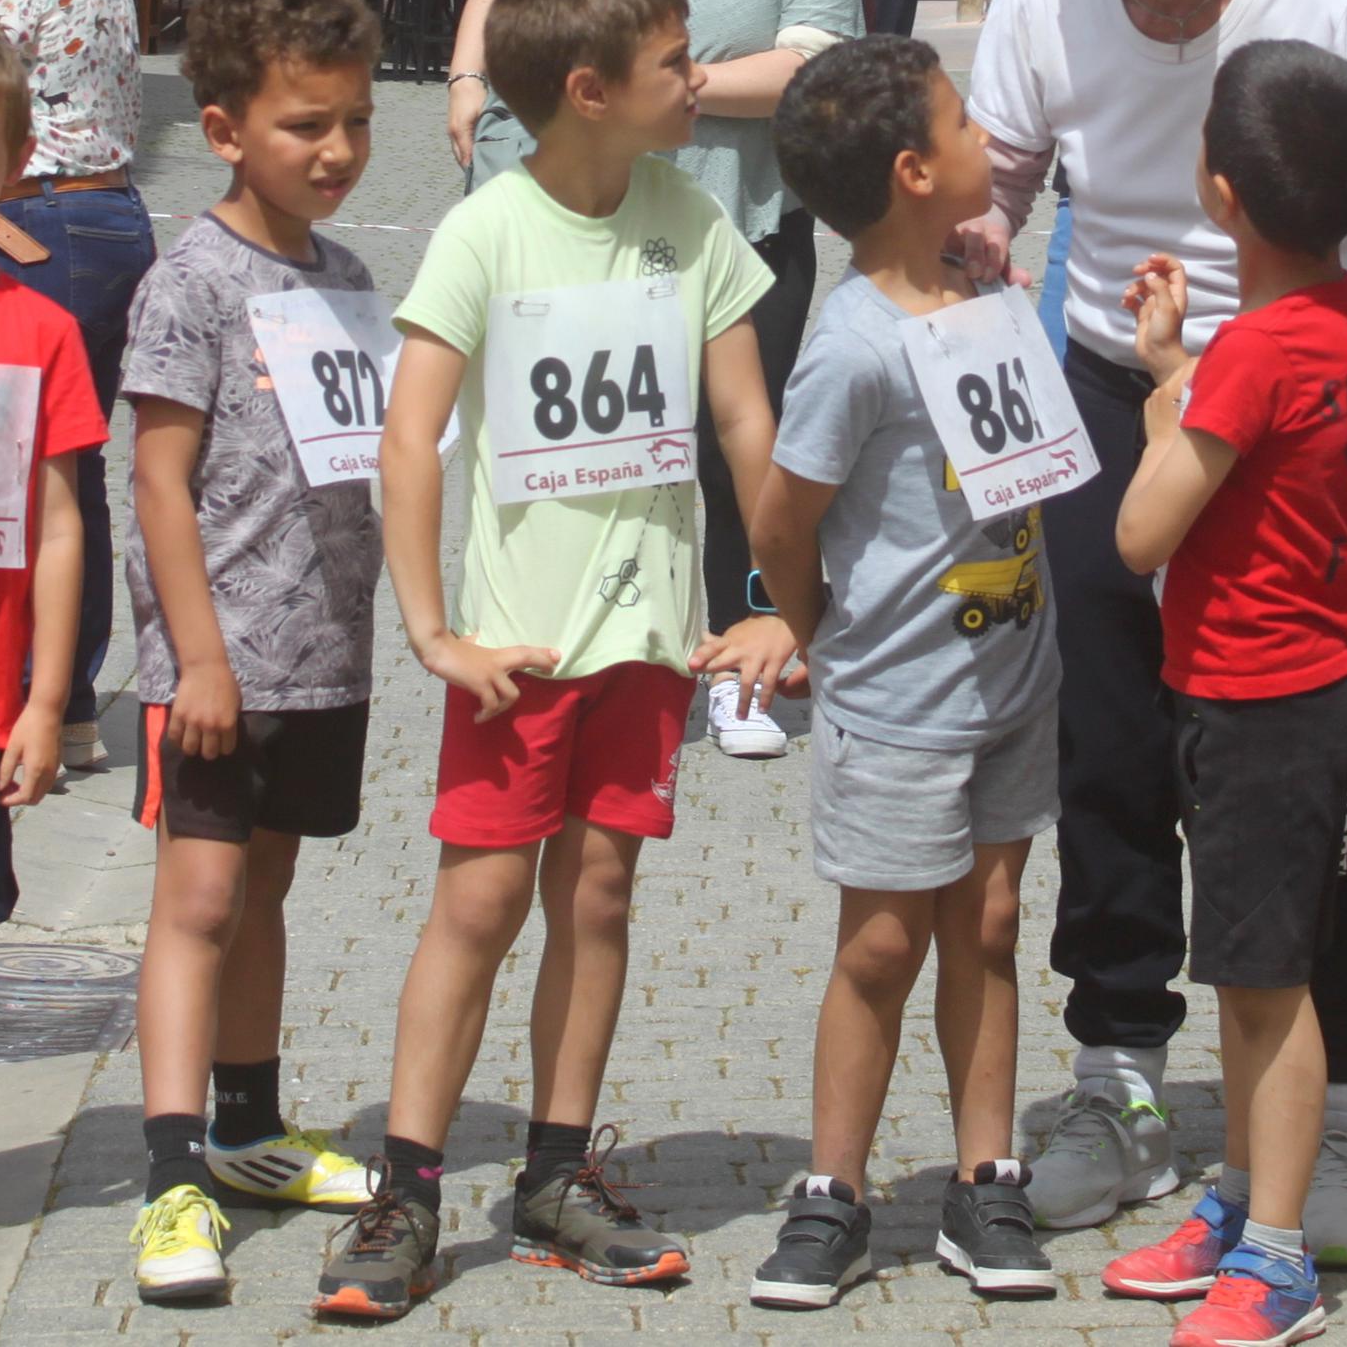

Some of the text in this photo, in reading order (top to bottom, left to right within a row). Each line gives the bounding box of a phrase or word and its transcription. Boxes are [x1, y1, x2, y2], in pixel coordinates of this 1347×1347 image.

[529, 344, 667, 441] 864
[329, 456, 380, 475] Caja Esp
[524, 461, 644, 494] Caja España
[983, 484, 1015, 507] Caja
